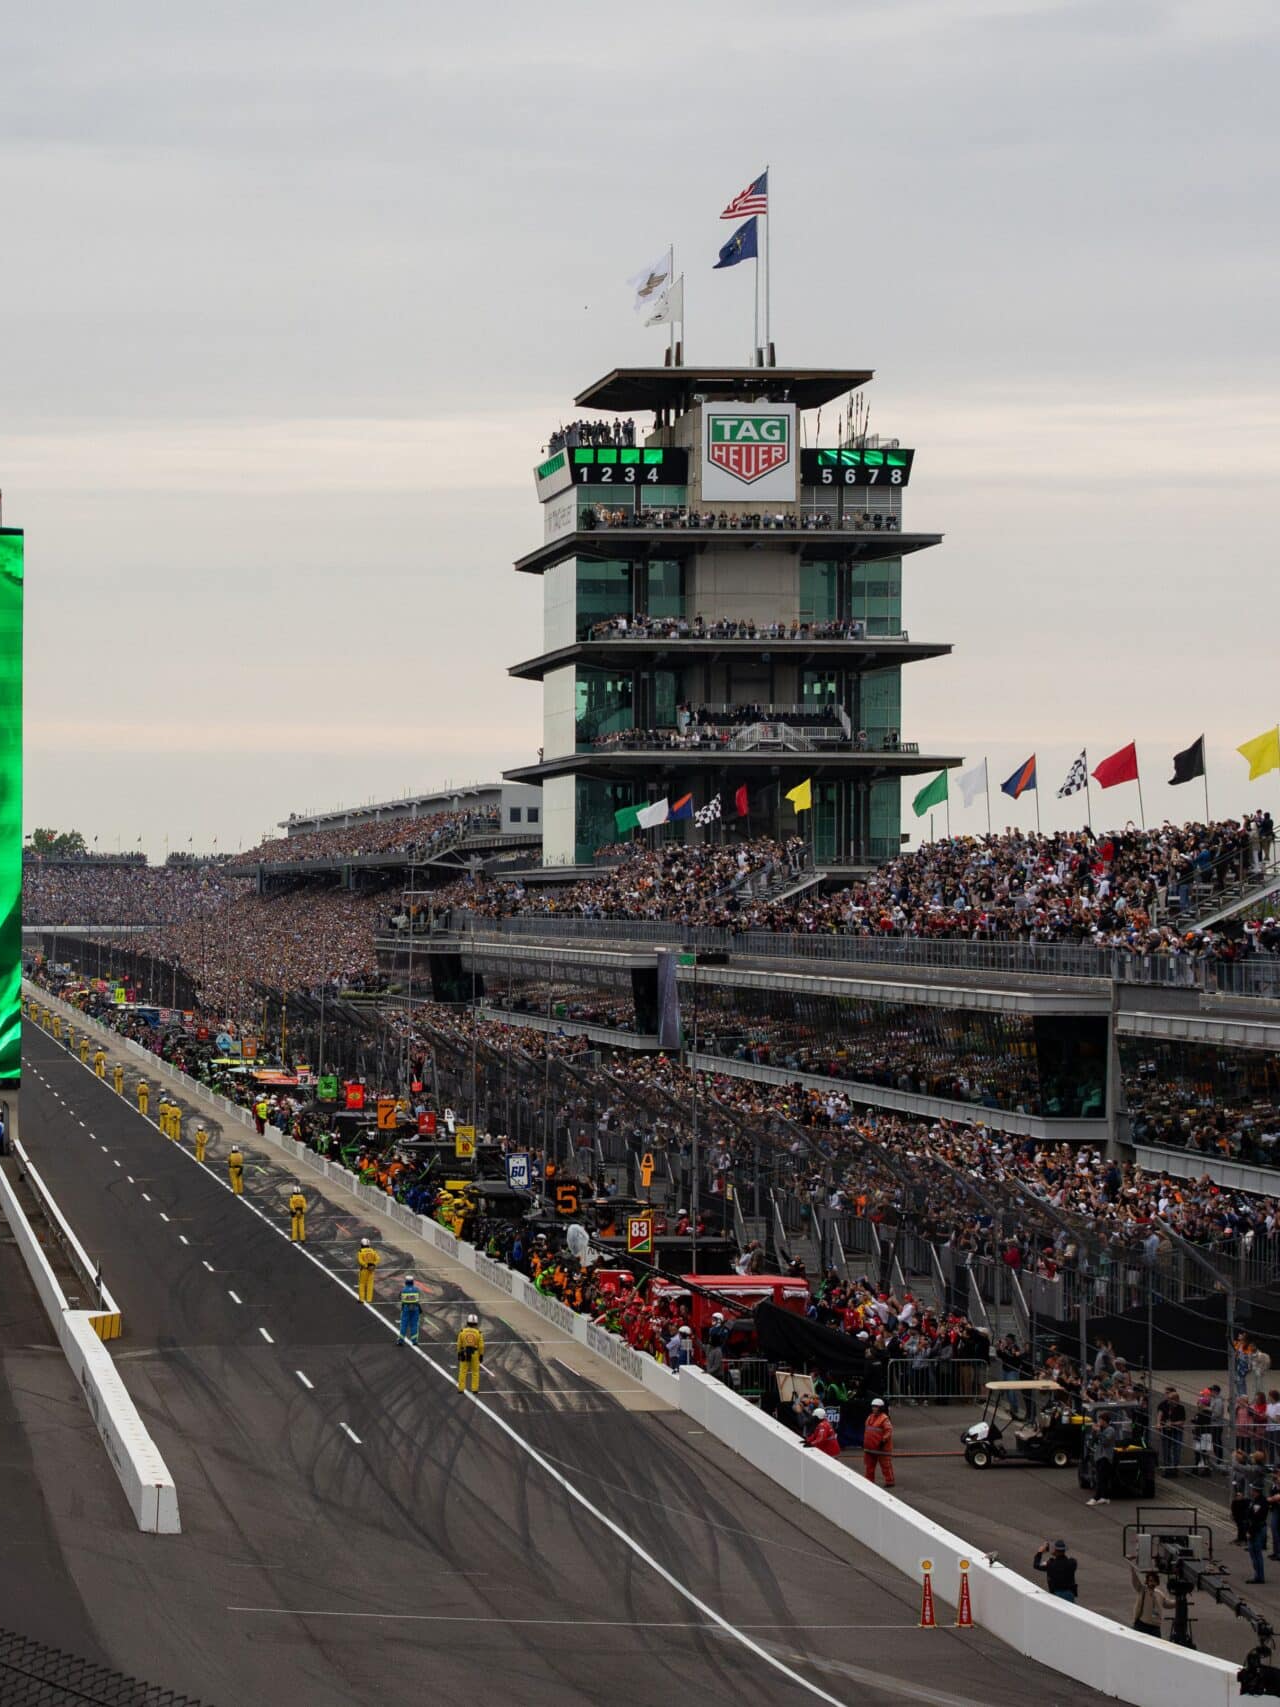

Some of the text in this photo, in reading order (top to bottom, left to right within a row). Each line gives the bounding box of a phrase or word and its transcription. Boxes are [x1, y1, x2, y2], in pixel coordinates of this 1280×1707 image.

[714, 419, 781, 441] TAG
[712, 446, 786, 479] HEUER
[580, 467, 659, 482] 1 2 3 4
[821, 469, 902, 484] 5 6 7 8
[462, 1142, 470, 1152] 10
[512, 1166, 525, 1177] 60
[556, 1185, 577, 1214] 5
[631, 1222, 648, 1237] 83
